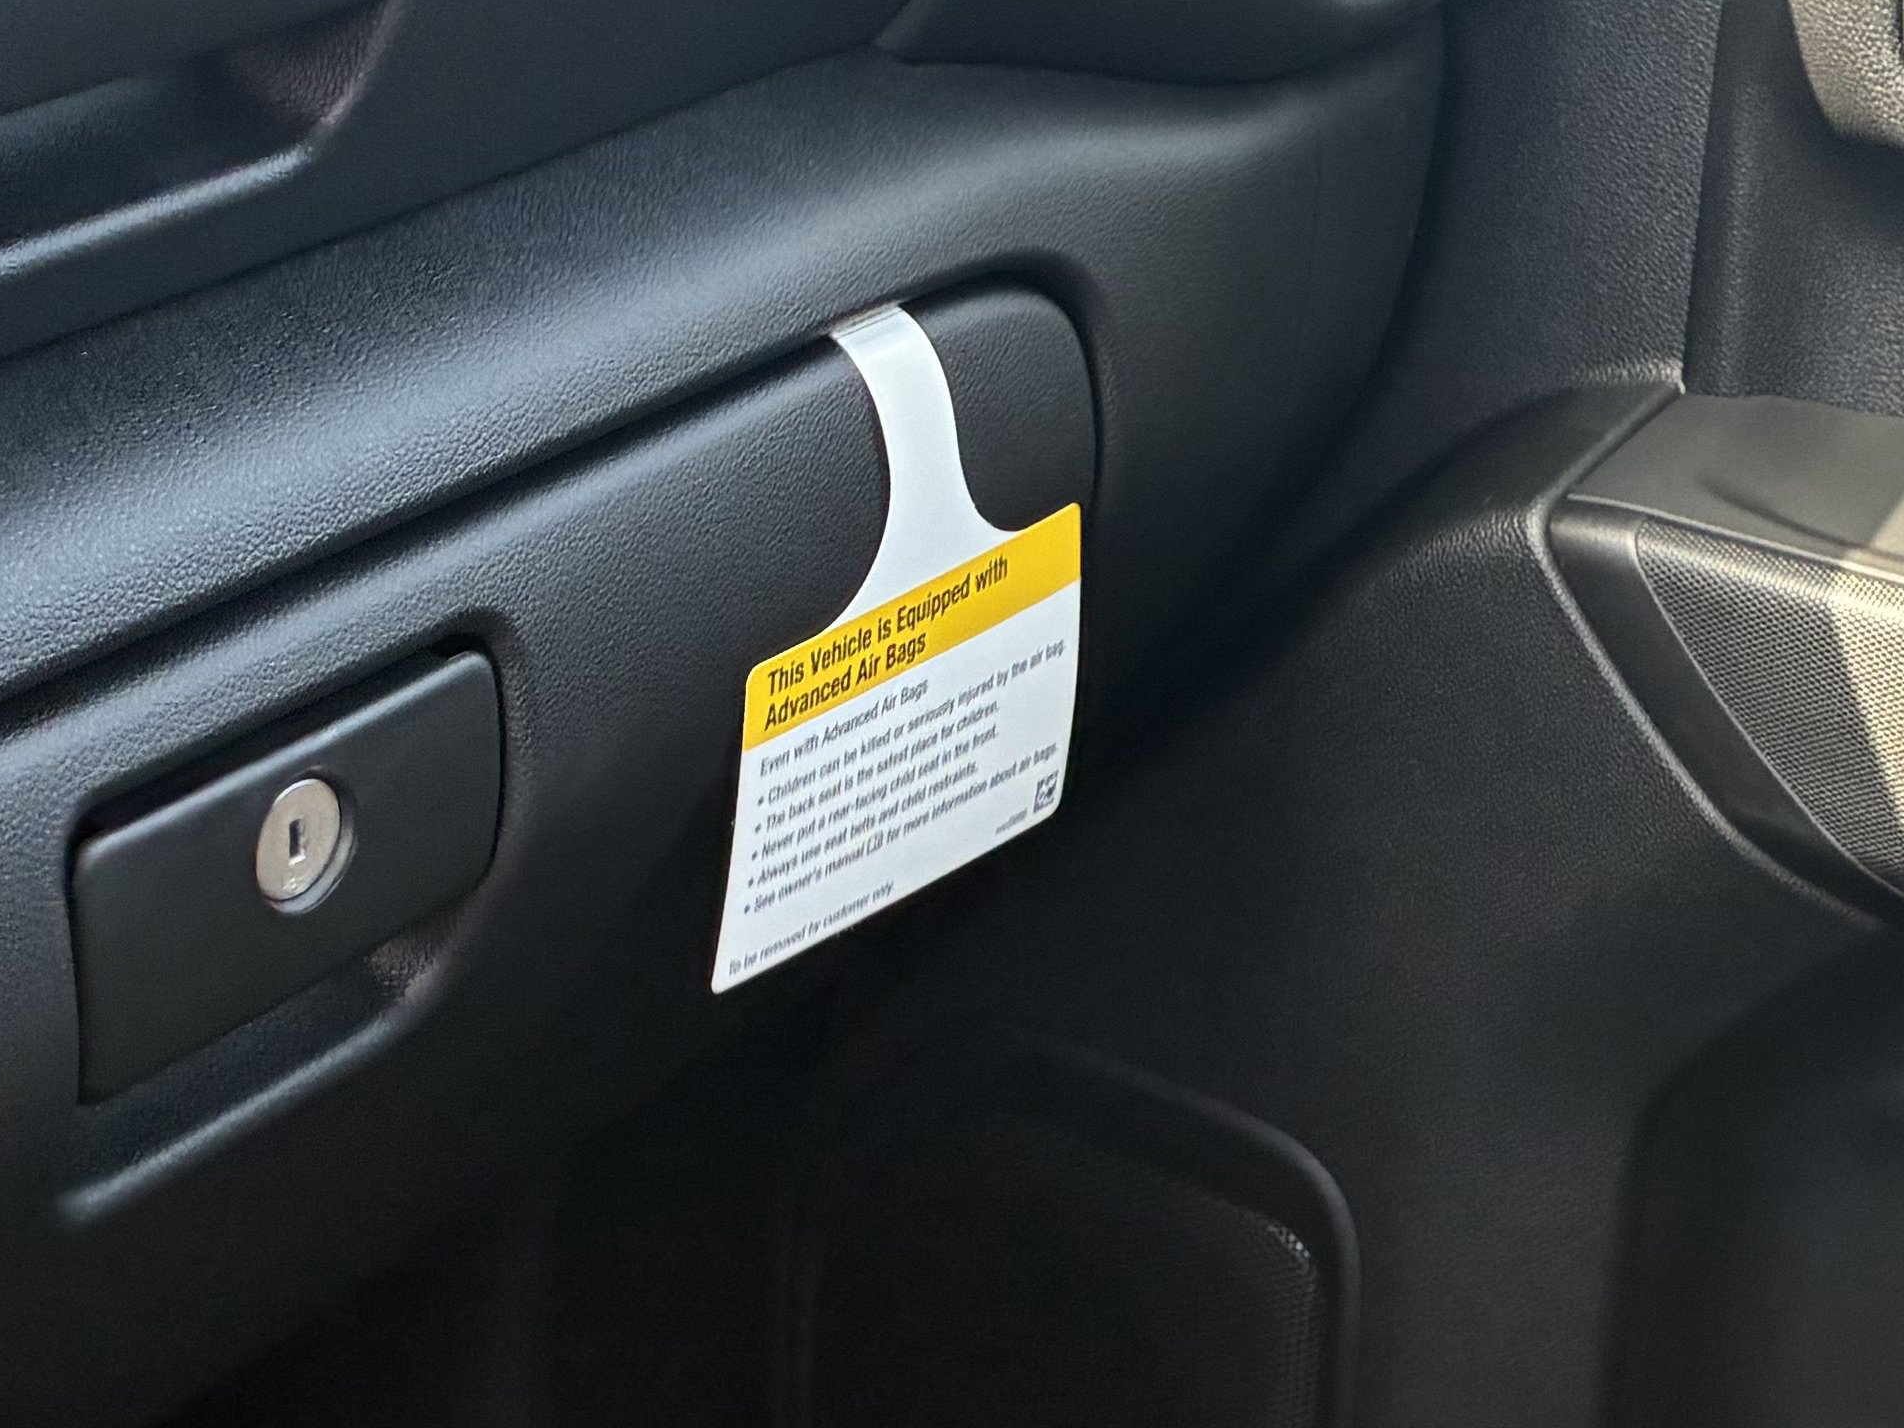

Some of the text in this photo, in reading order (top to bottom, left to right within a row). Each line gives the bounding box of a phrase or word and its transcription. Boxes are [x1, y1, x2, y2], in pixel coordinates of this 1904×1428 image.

[765, 633, 926, 731] Advanced Air Bags
[768, 555, 1007, 696] This Vehicle is Equipped with
[760, 679, 928, 777] Even with Advanced Air Bags
[762, 725, 999, 860] Never put a rear-facing child seat in the front.
[767, 700, 999, 832] The back seat is the safest place for children.
[768, 768, 816, 805] Children
[820, 757, 840, 779] can
[844, 748, 857, 766] be
[861, 728, 891, 756] killed
[894, 724, 905, 739] or
[908, 698, 955, 733] seriously
[958, 673, 994, 707] injured
[997, 668, 1009, 687] by
[1012, 659, 1028, 678] the
[1030, 649, 1043, 670] air
[754, 890, 776, 913] See
[778, 866, 822, 901] owner's
[825, 840, 865, 877] manual
[887, 823, 901, 843] for
[903, 811, 930, 837] more
[931, 779, 988, 820] information
[989, 761, 1018, 789] about
[1019, 756, 1031, 773] air
[757, 760, 979, 886] Always use seat belts and child restraints.
[729, 958, 741, 976] To
[744, 951, 757, 970] be
[760, 924, 806, 960] removed
[808, 921, 822, 938] by
[823, 893, 870, 929] customer
